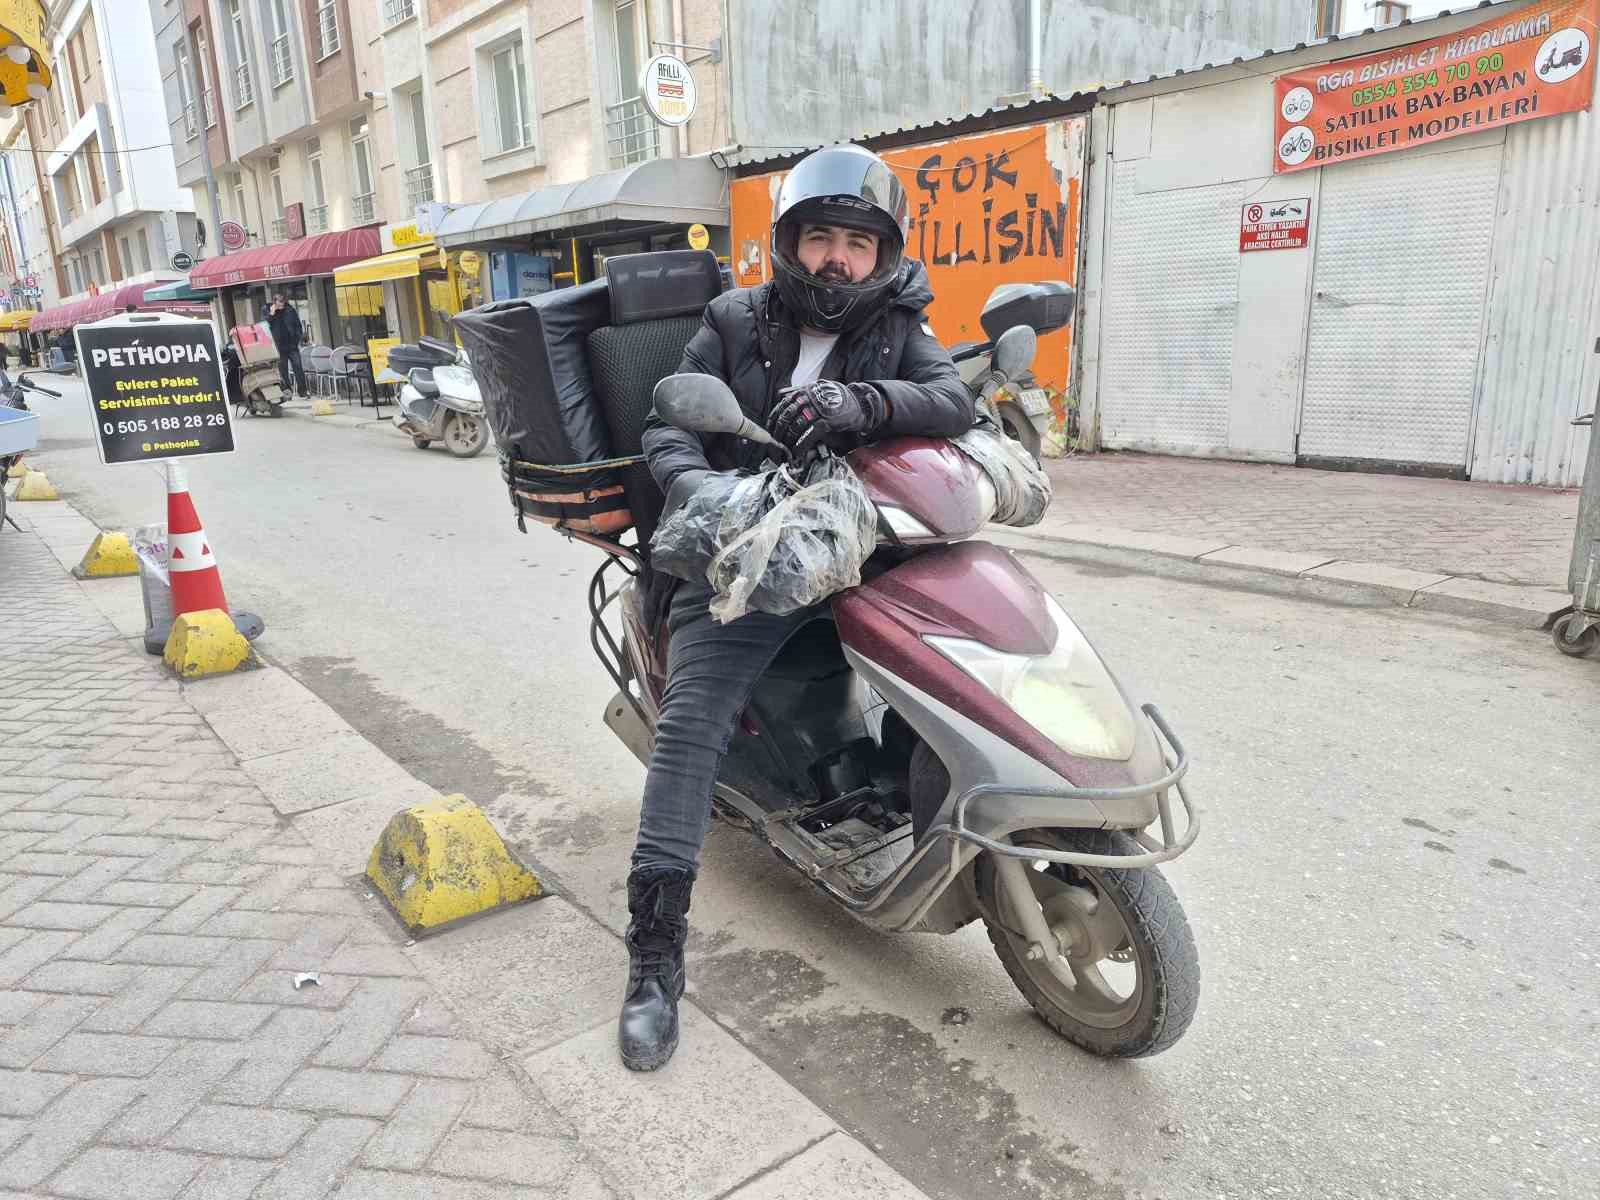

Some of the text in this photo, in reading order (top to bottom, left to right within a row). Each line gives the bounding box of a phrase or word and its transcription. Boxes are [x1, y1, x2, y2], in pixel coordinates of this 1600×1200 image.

[1352, 52, 1504, 106] 0554 354 70 90
[1325, 70, 1527, 133] SATILIK BAY-BAYAN
[1408, 90, 1538, 142] MODELLERİ
[916, 149, 1018, 205] ÇOK
[822, 196, 873, 212] LS2
[1242, 224, 1258, 233] PARK
[91, 341, 212, 368] PETHOPIA
[115, 376, 199, 391] Evlere Paket
[99, 395, 171, 410] Servisimiz
[172, 391, 213, 405] Vardır
[103, 413, 226, 435] 0 505 188 28 26
